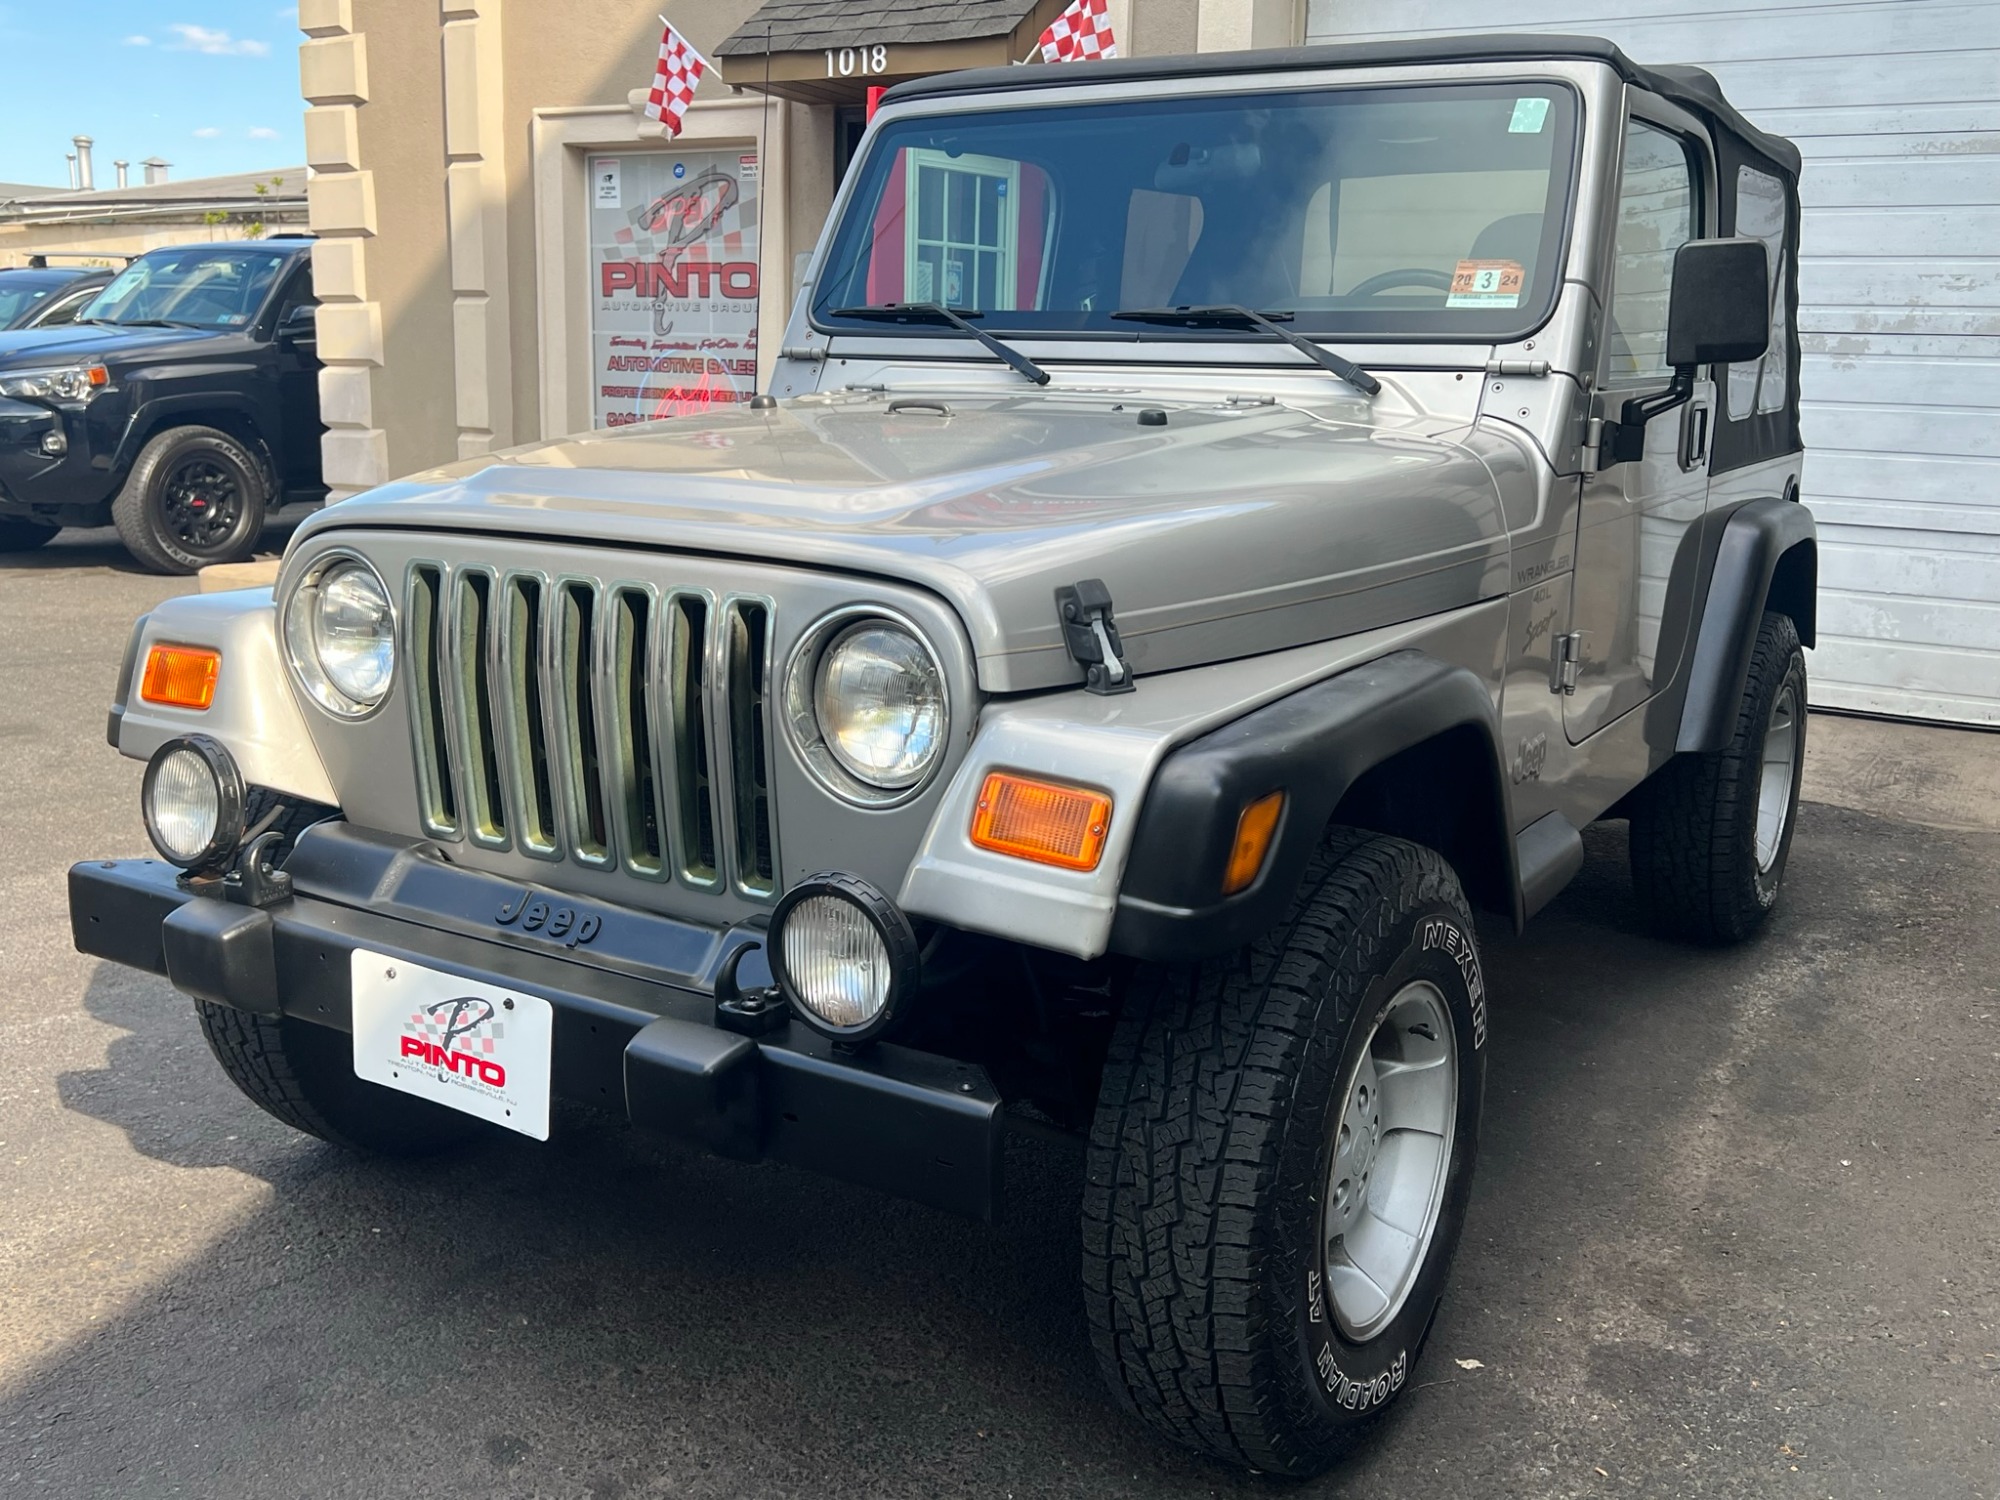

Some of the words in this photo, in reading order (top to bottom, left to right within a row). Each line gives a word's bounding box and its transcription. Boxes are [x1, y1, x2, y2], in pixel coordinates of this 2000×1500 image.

[824, 44, 887, 77] 1018
[601, 262, 758, 299] PINTO
[1456, 274, 1472, 286] 20
[1481, 271, 1493, 289] 3
[1502, 275, 1519, 286] 24
[601, 301, 701, 312] AUTOMOTIVE
[709, 303, 758, 313] GROU
[607, 355, 704, 373] AUTOMOTIVE
[707, 359, 756, 375] SALES
[1517, 554, 1570, 583] WRANGLER
[1512, 732, 1546, 785] Jeep
[495, 890, 602, 948] Jeep
[1422, 922, 1485, 1050] NEXEN
[400, 1035, 505, 1088] PINTO
[400, 1058, 467, 1082] AUTOMOTIVE
[471, 1080, 506, 1095] GROUP
[1317, 1341, 1406, 1411] ROADIAN
